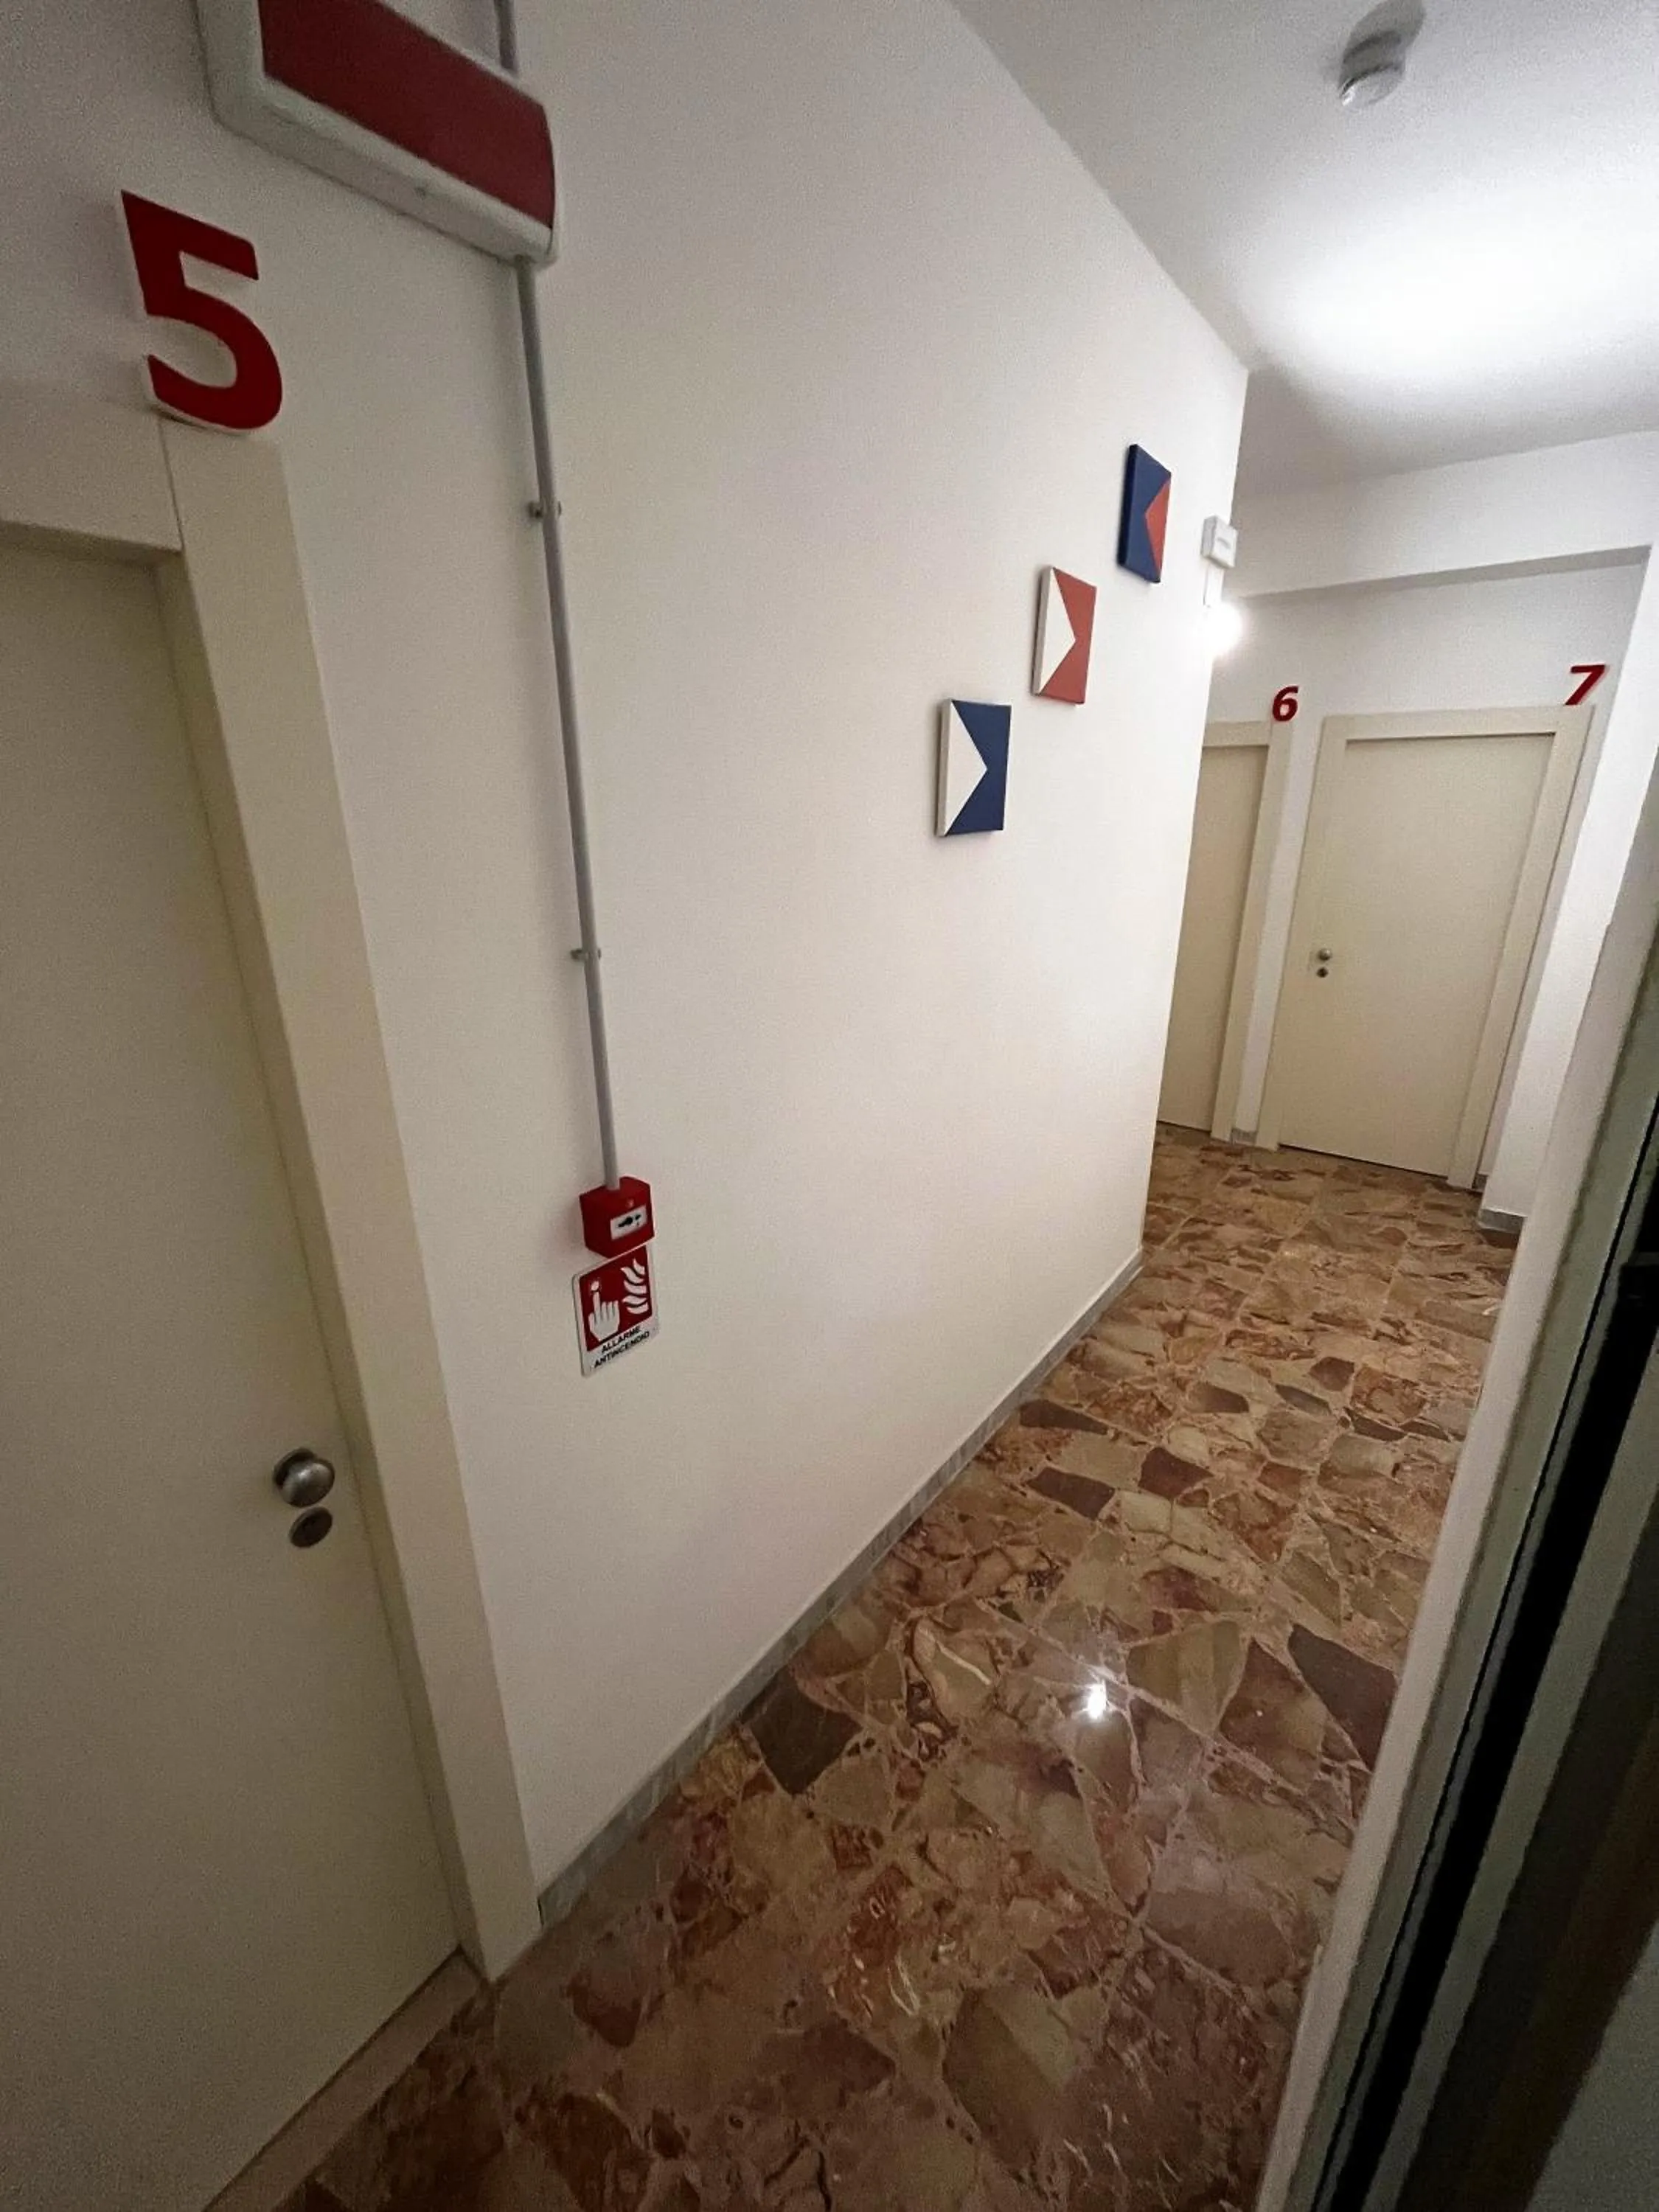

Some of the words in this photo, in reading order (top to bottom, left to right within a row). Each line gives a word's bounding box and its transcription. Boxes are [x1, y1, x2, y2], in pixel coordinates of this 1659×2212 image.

[121, 189, 283, 430] 5
[1271, 686, 1298, 721] 6
[1565, 664, 1606, 706] 7
[602, 1325, 641, 1353] ALLARME
